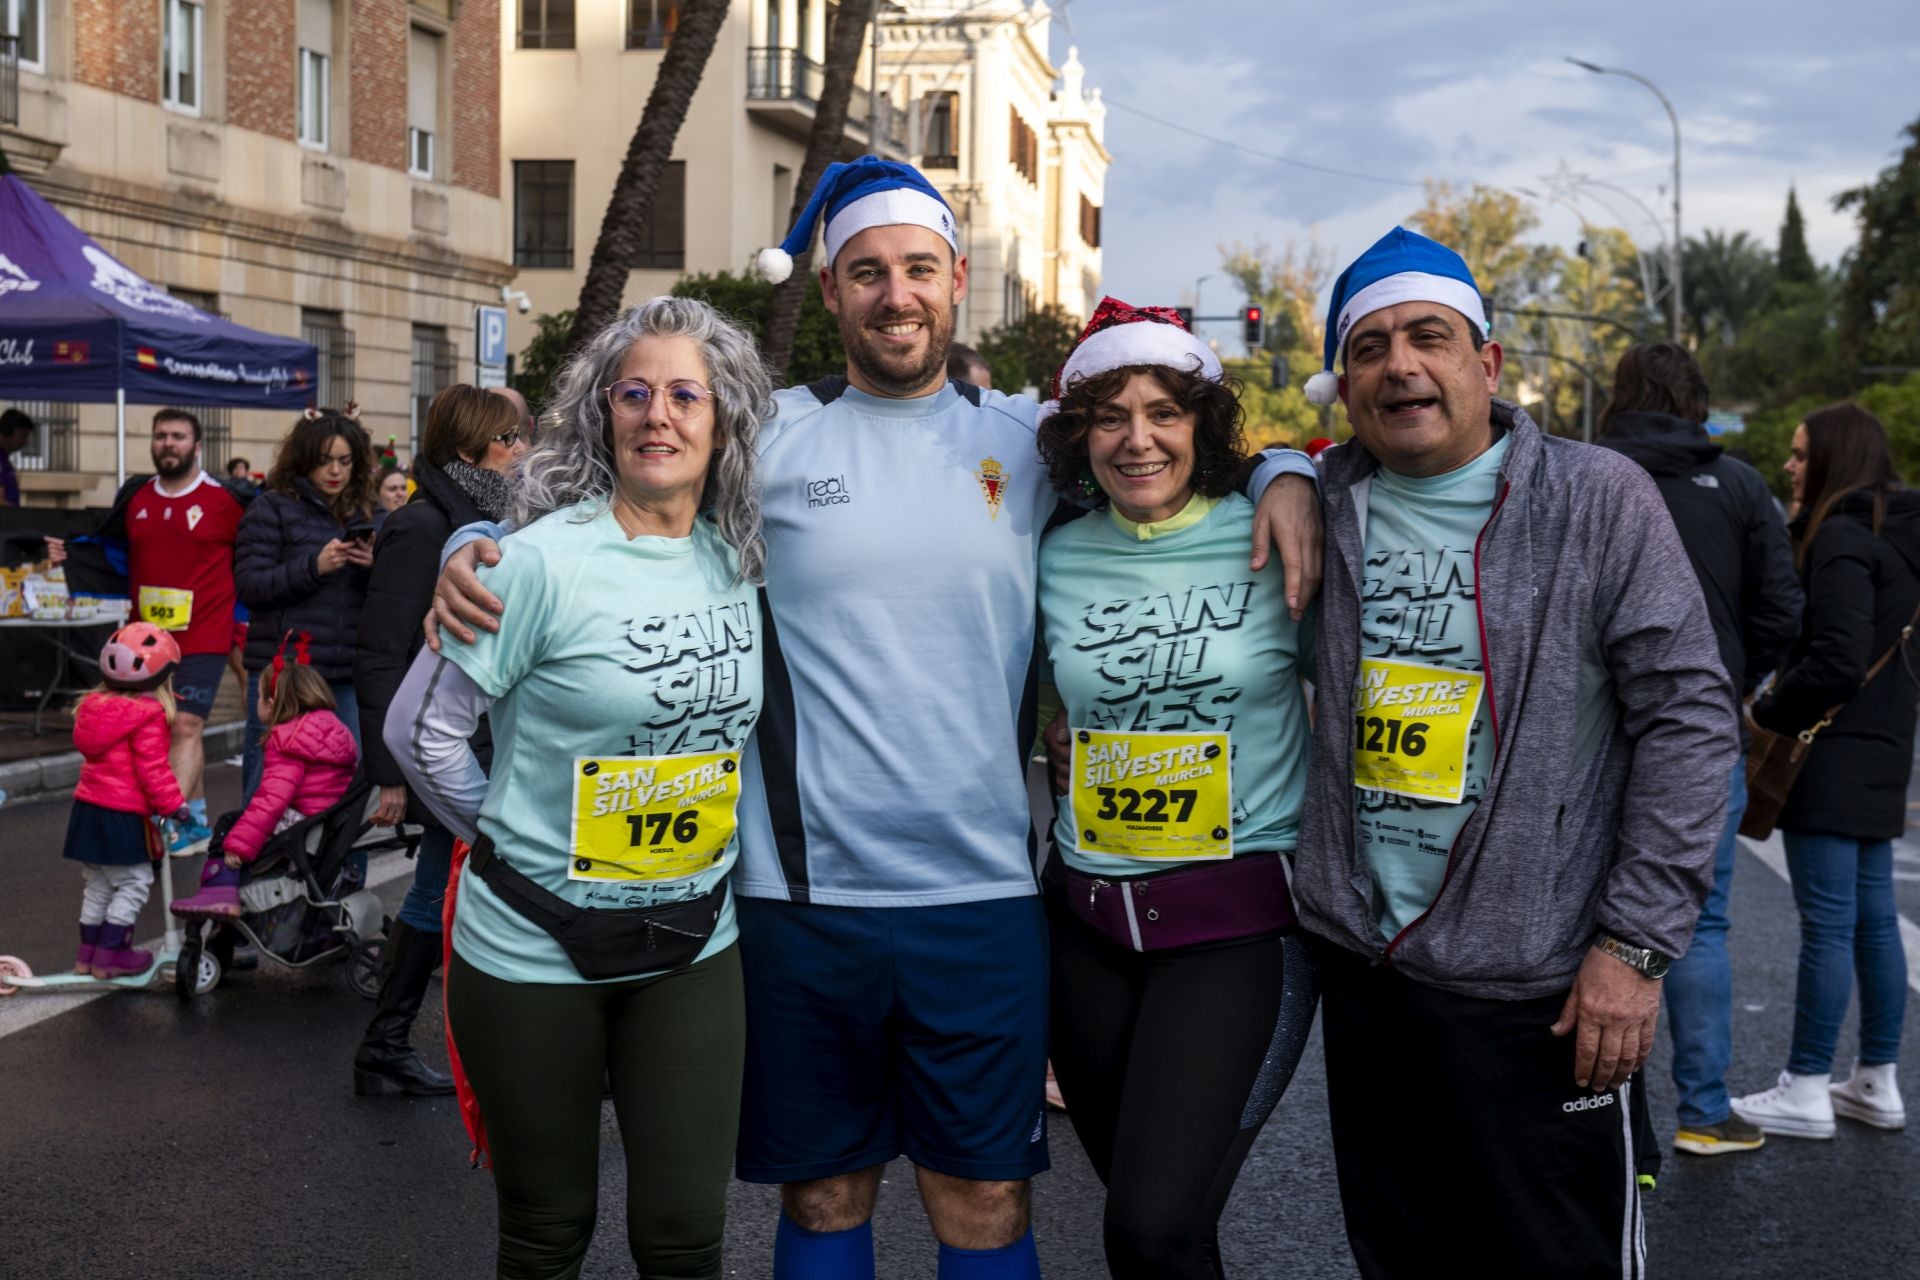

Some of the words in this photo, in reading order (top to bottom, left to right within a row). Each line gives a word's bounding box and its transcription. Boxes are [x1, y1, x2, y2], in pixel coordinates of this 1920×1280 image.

[487, 314, 503, 360] P
[807, 474, 848, 498] real
[808, 495, 850, 509] murcia
[150, 606, 175, 618] 503
[1073, 581, 1255, 651] SAN
[622, 602, 753, 673] SAN
[1362, 603, 1463, 657] SIL
[1097, 636, 1222, 705] SIL
[1353, 668, 1389, 690] AN
[643, 659, 751, 730] SIL
[1353, 679, 1470, 714] LVESTRE
[1402, 702, 1461, 718] MURCIA
[1086, 740, 1130, 766] SAN
[1354, 716, 1431, 757] 1216
[592, 759, 730, 818] SILVESTRE
[595, 766, 656, 795] SAN
[1155, 764, 1214, 787] MURCIA
[676, 783, 728, 809] MURCIA
[1096, 786, 1198, 823] 3227
[626, 810, 700, 847] 176
[1562, 1093, 1614, 1112] adidas
